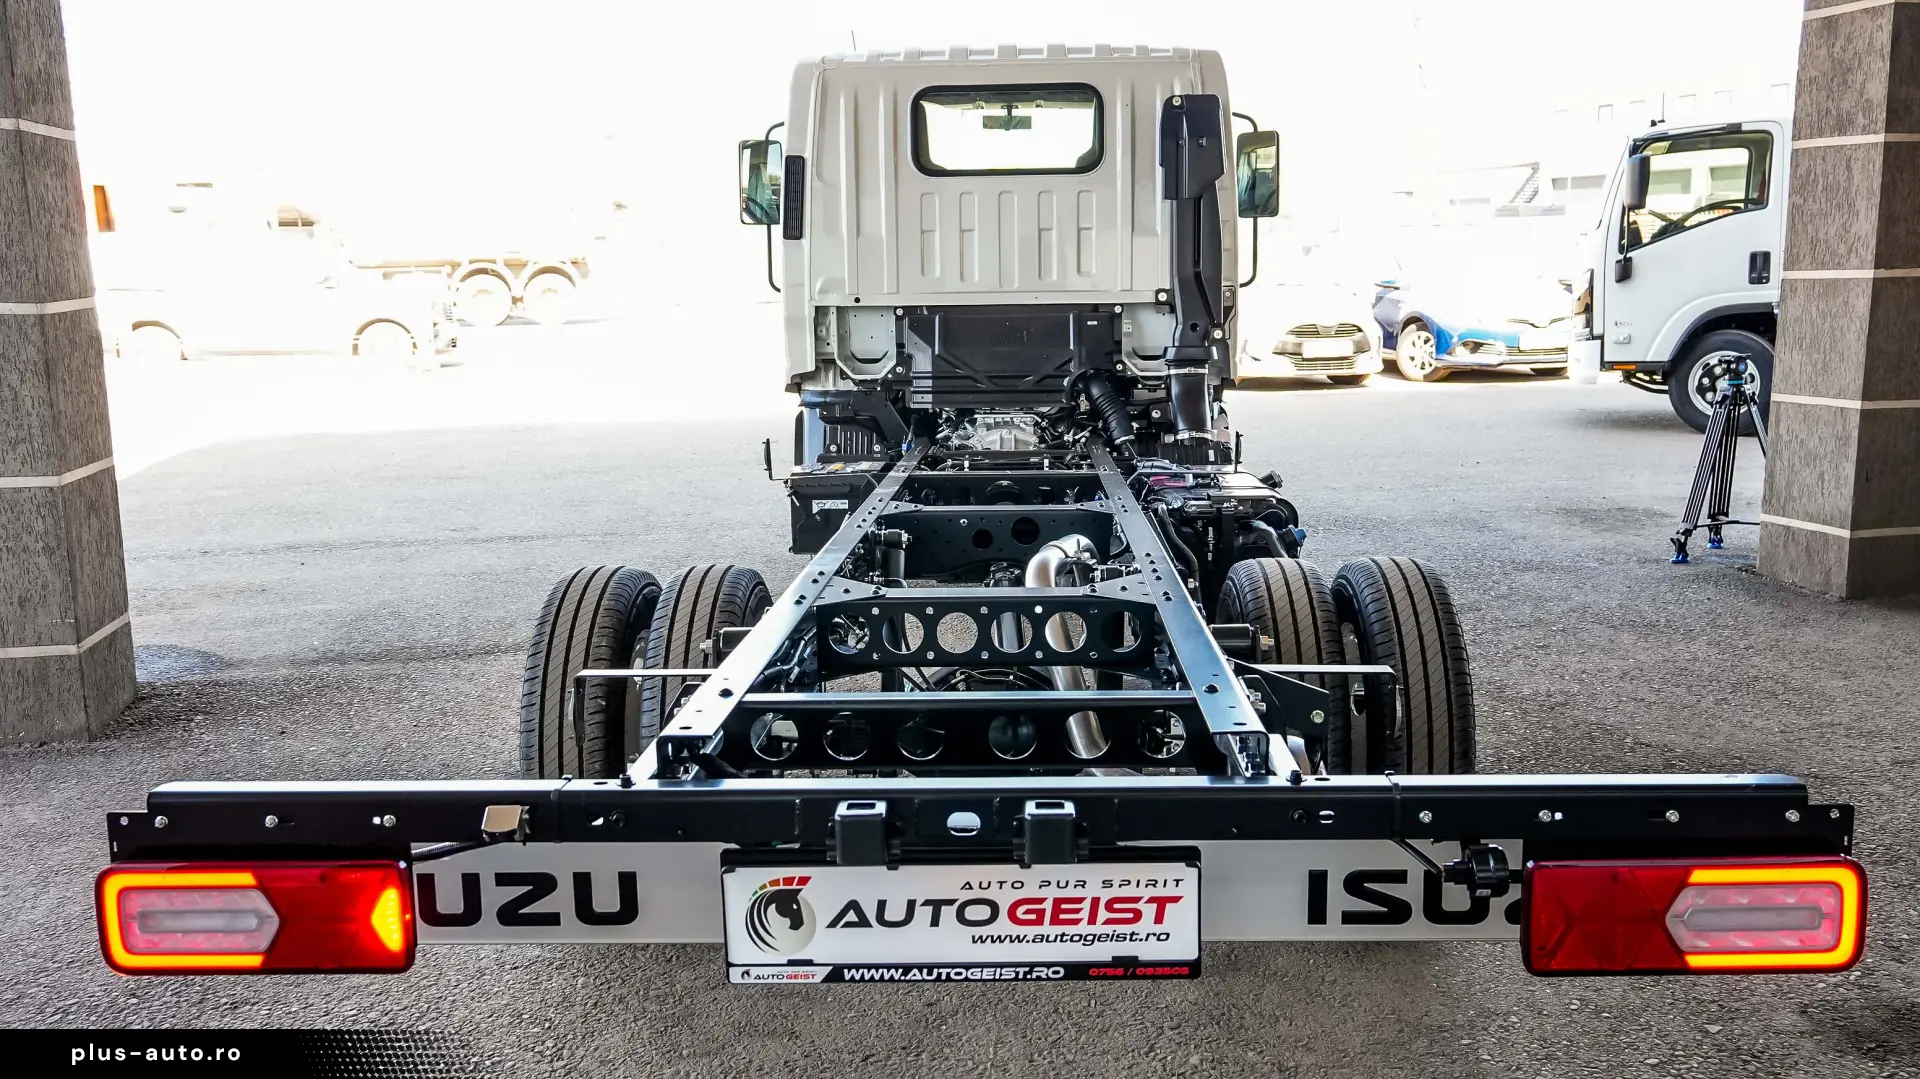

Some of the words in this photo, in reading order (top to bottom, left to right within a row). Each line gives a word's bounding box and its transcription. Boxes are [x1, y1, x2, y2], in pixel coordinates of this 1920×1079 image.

[960, 880, 1025, 891] AUTO
[1039, 879, 1087, 890] PUR
[1101, 878, 1185, 889] SPIRIT
[1307, 869, 1522, 926] ISU
[825, 895, 1185, 929] AUTOGEIST
[971, 929, 1171, 946] www.autogeist.ro
[753, 973, 818, 981] AUTOGEIST
[843, 966, 1065, 981] WWW.AUTOGEIST.RO
